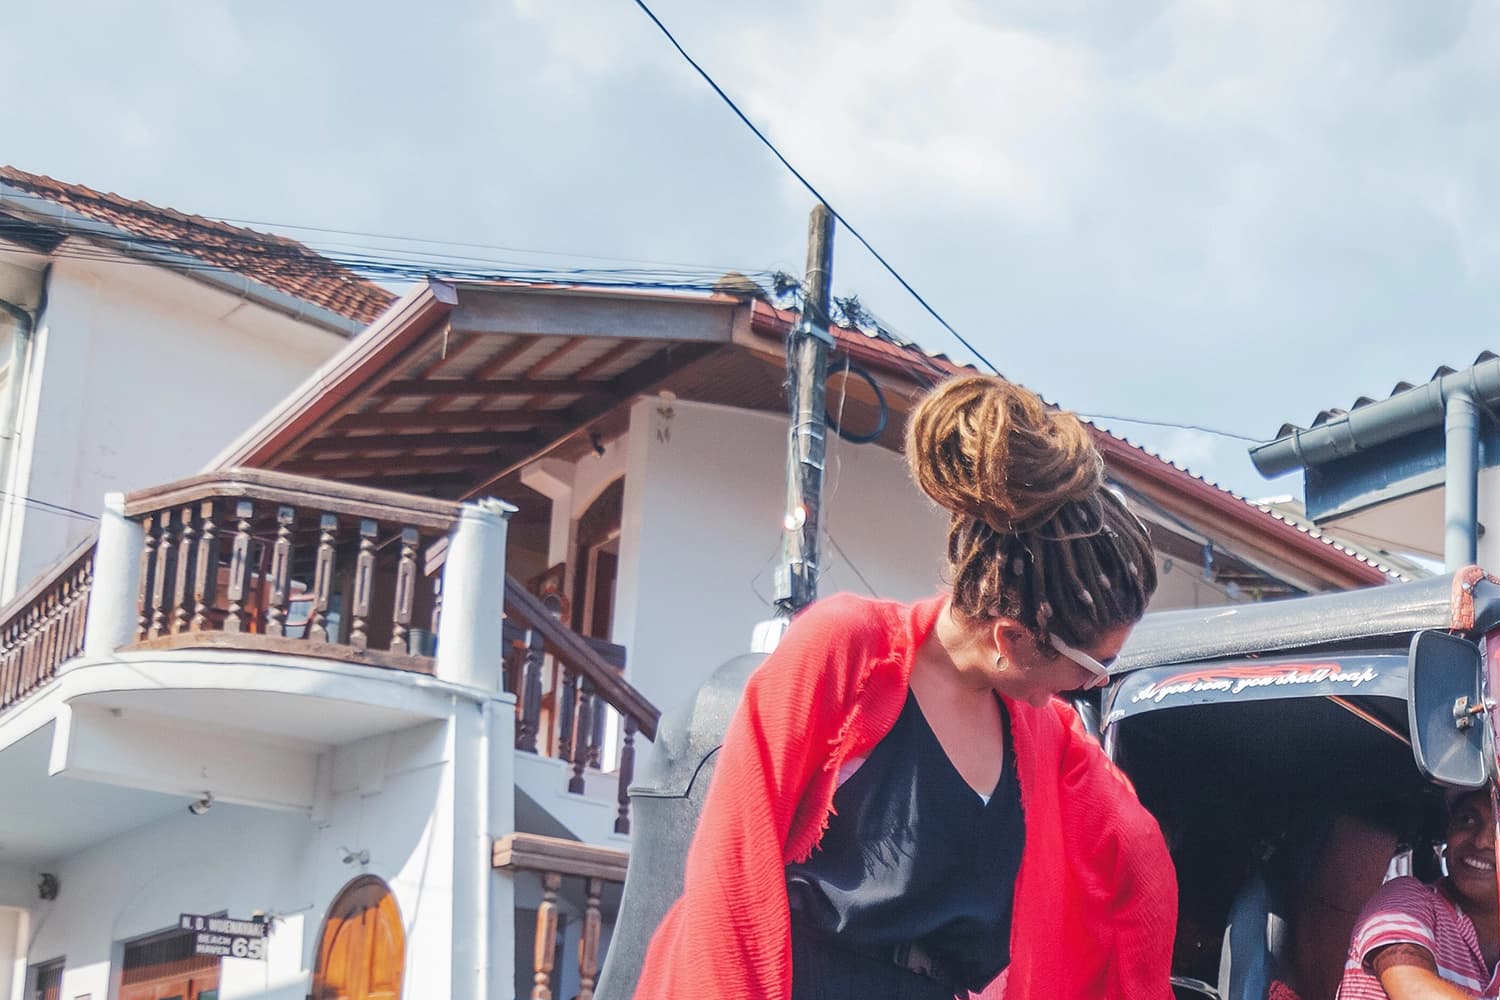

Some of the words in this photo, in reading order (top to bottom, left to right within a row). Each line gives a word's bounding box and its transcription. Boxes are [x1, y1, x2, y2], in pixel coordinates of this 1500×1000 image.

[1154, 683, 1196, 703] you
[1232, 676, 1278, 694] you
[1276, 668, 1332, 685] shall
[1330, 667, 1379, 688] reap
[197, 933, 231, 945] BEACH
[196, 944, 230, 955] HAVEN
[231, 937, 261, 959] 65
